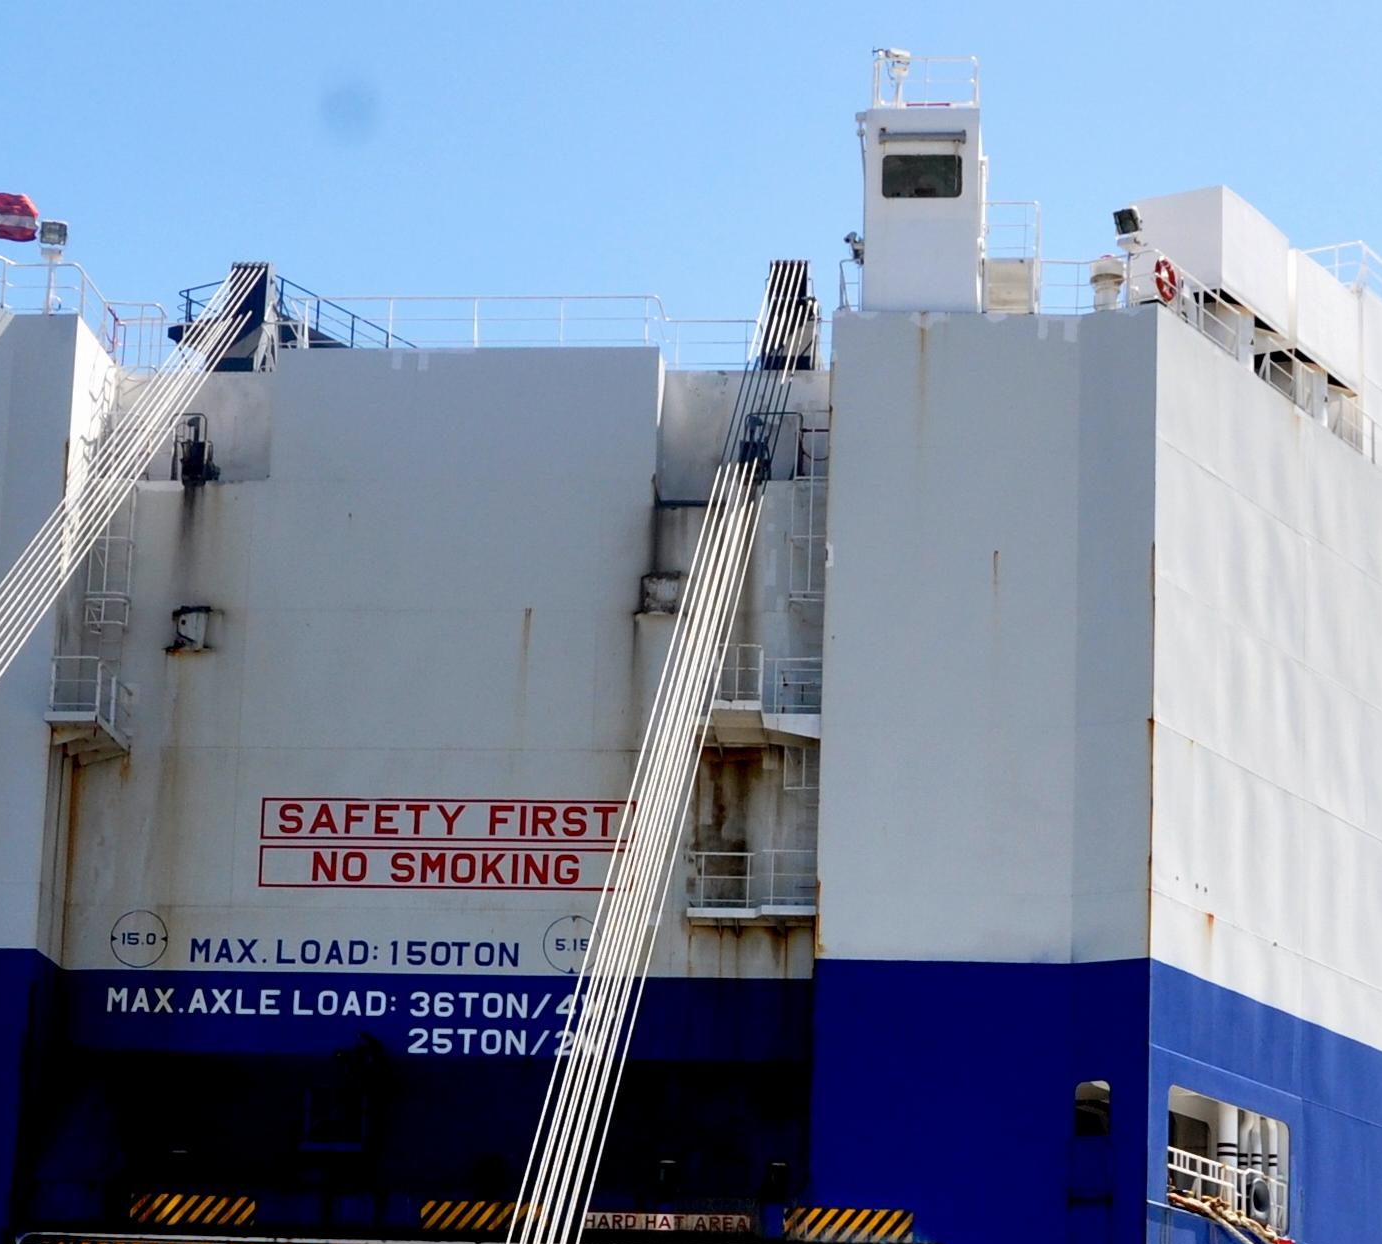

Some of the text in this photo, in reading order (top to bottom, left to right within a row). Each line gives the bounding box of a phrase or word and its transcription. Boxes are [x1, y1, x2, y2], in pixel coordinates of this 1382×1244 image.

[278, 803, 619, 838] SAFETY FIRST
[311, 851, 581, 886] NO SMOKING
[121, 931, 157, 946] 15.0
[555, 937, 589, 952] 5.15
[292, 989, 398, 1018] LOAD:
[584, 1213, 749, 1232] HARD HAT AREA
